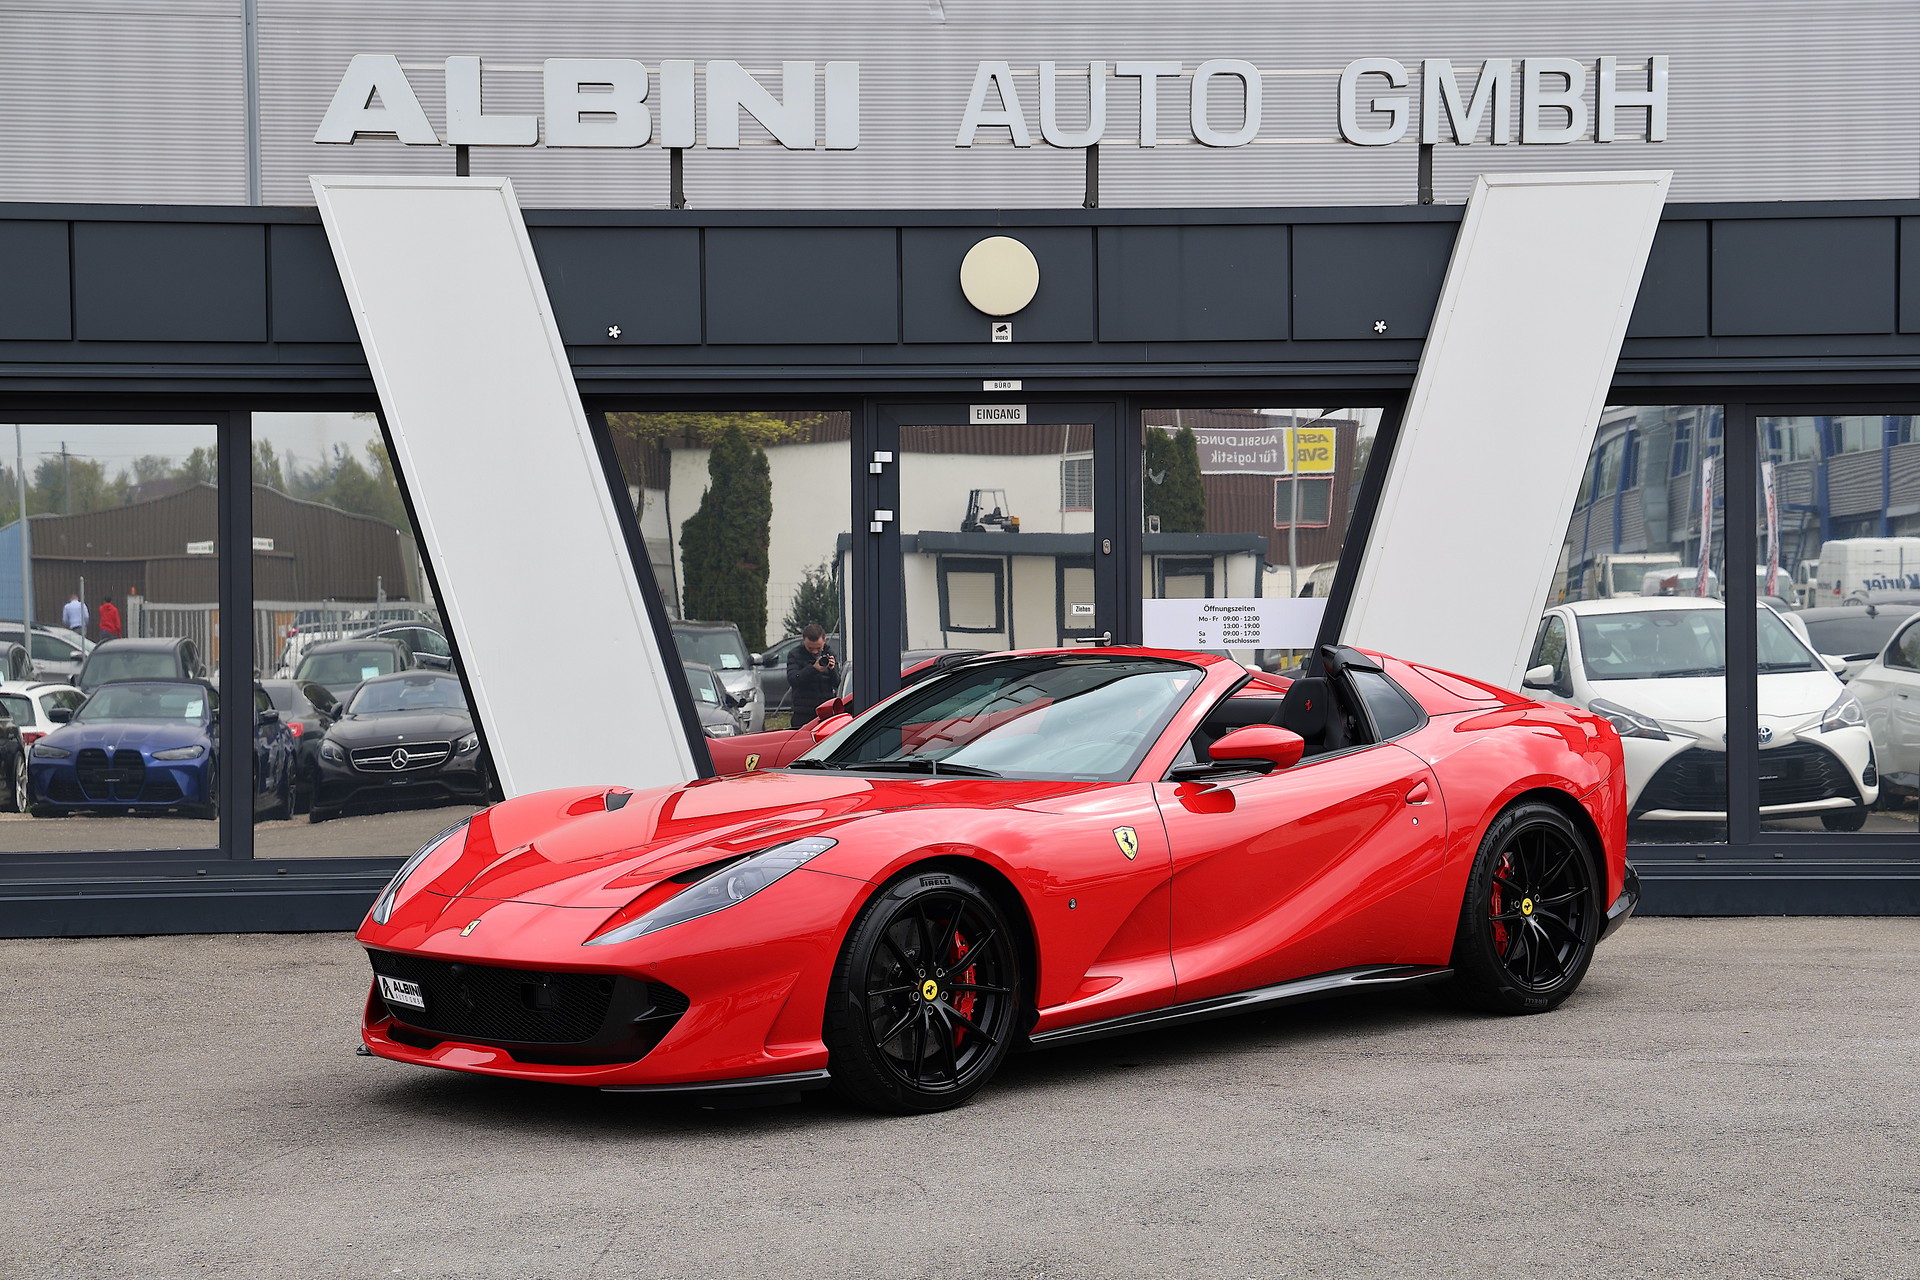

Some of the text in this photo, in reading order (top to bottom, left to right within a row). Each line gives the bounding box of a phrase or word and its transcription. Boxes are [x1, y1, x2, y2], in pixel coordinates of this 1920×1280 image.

[313, 53, 1670, 151] ALBINI AUTO GMBH
[976, 408, 1020, 419] EINGANG
[1203, 604, 1255, 613] Öffnungszeiten
[919, 875, 951, 887] PIRELLI
[393, 980, 422, 998] ALBINI
